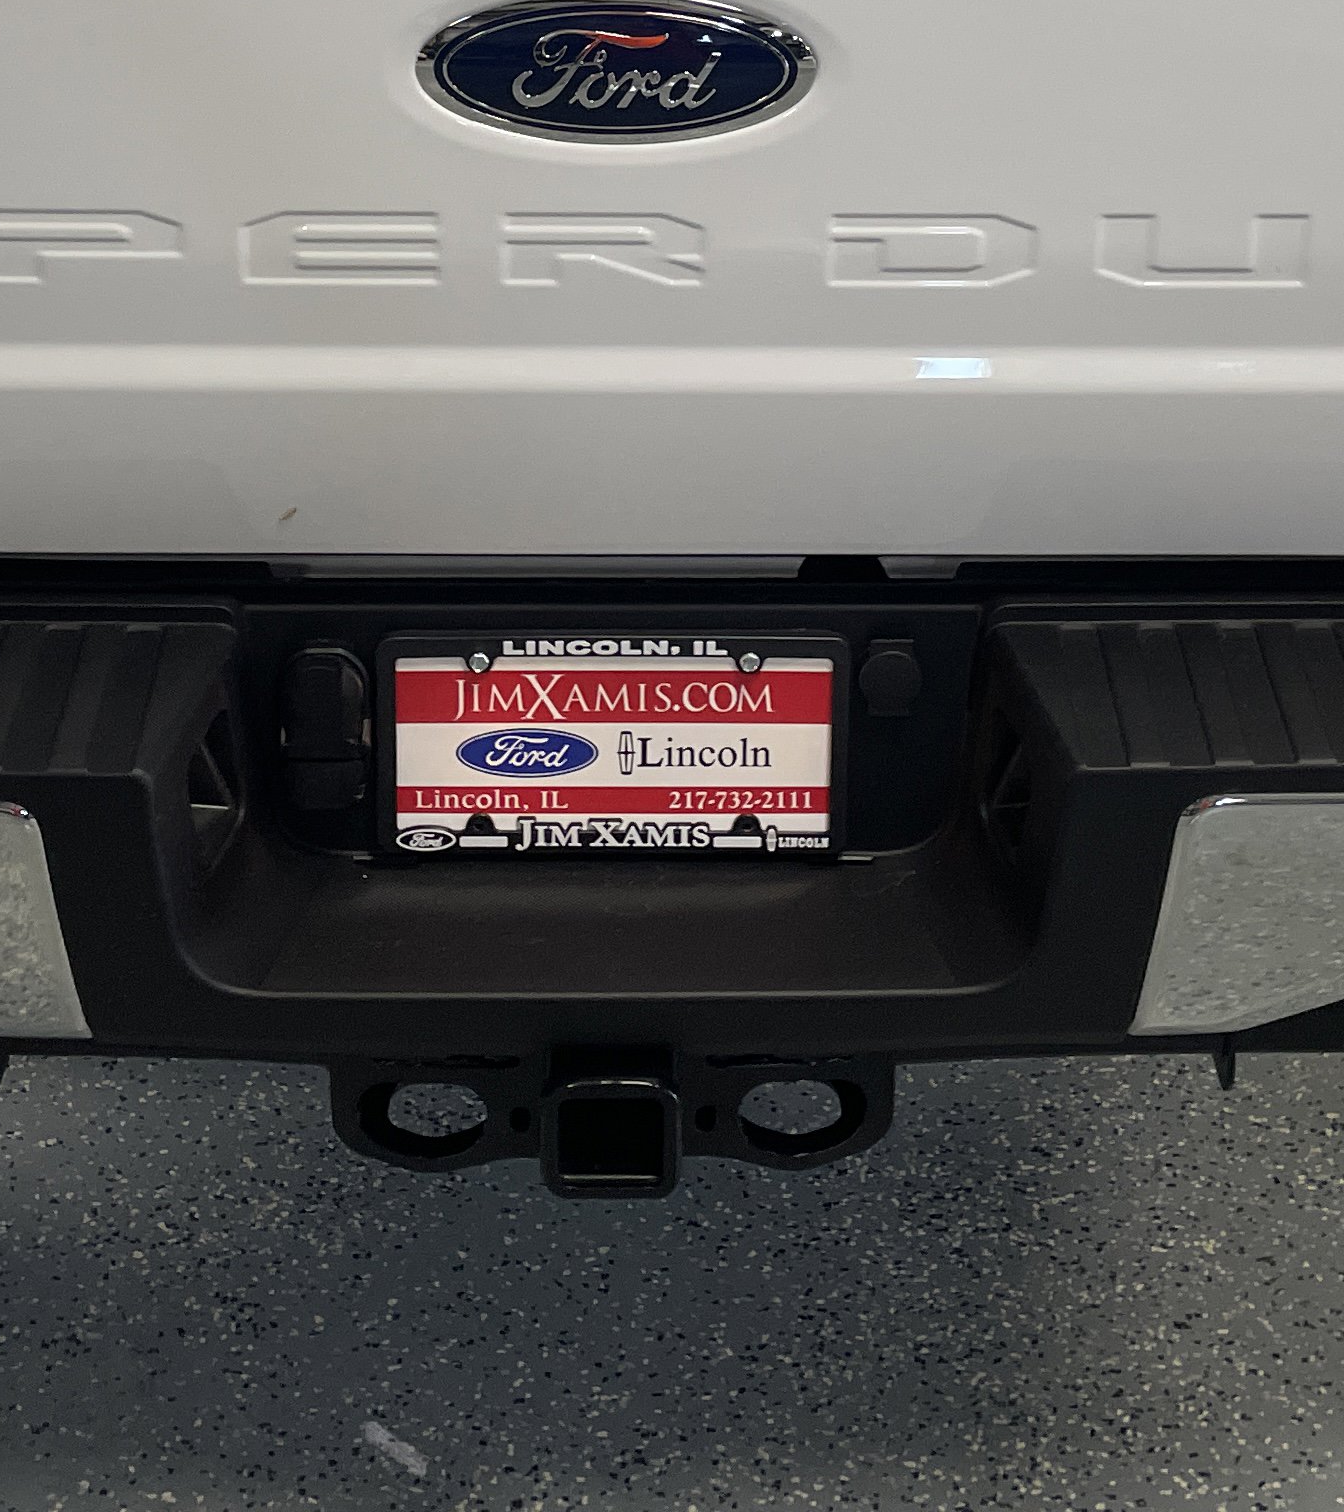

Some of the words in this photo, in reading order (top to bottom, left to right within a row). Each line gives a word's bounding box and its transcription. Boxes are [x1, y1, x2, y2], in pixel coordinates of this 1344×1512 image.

[512, 29, 722, 110] Ford
[503, 640, 681, 656] LINCOLN,
[693, 640, 729, 656] IL
[486, 735, 570, 769] Ford
[636, 737, 772, 768] Lincoln
[416, 789, 530, 811] Lincoln,
[541, 790, 569, 810] IL
[668, 790, 813, 810] 217-732-2111
[515, 820, 582, 851] JIM
[590, 820, 711, 848] XAMIS
[778, 837, 830, 849] LINCOLN
